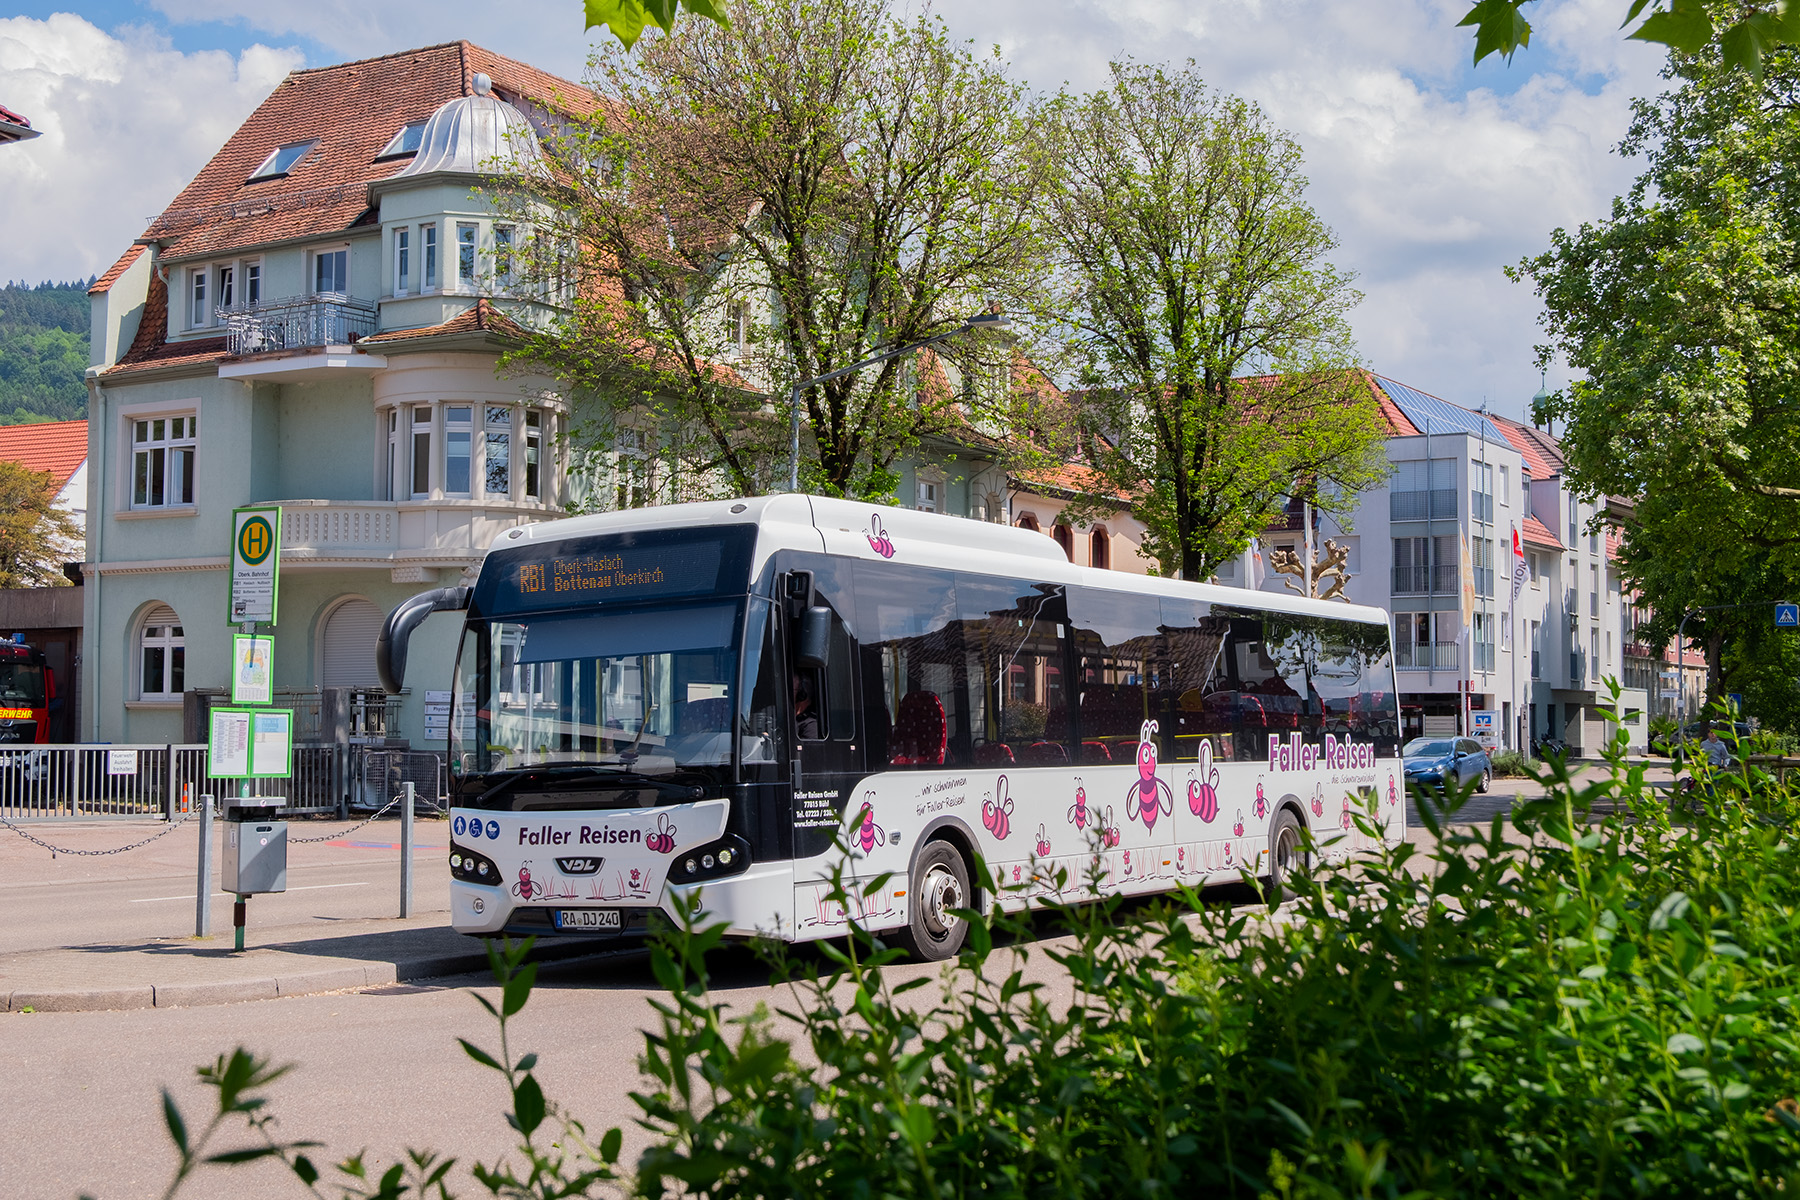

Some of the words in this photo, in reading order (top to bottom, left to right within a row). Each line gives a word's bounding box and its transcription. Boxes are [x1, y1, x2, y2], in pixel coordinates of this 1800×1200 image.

[248, 527, 263, 555] H
[553, 554, 624, 575] Oberk-Haslach
[520, 564, 546, 593] RB1
[554, 575, 612, 592] Bottenau
[615, 567, 664, 587] Oberkirch
[1267, 731, 1320, 772] Faller
[1325, 732, 1377, 770] Reisen
[794, 791, 808, 800] Faller
[808, 790, 823, 799] Reisen
[823, 790, 838, 798] GmbH
[921, 782, 932, 796] wir
[934, 777, 967, 793] schwärmen
[803, 800, 819, 809] 77815
[819, 800, 830, 808] Bühl
[916, 803, 926, 816] für
[518, 826, 571, 846] Faller
[579, 824, 642, 845] Reisen
[561, 859, 596, 871] VDL
[562, 912, 577, 926] RA
[582, 912, 597, 926] DJ
[598, 912, 619, 926] 240
